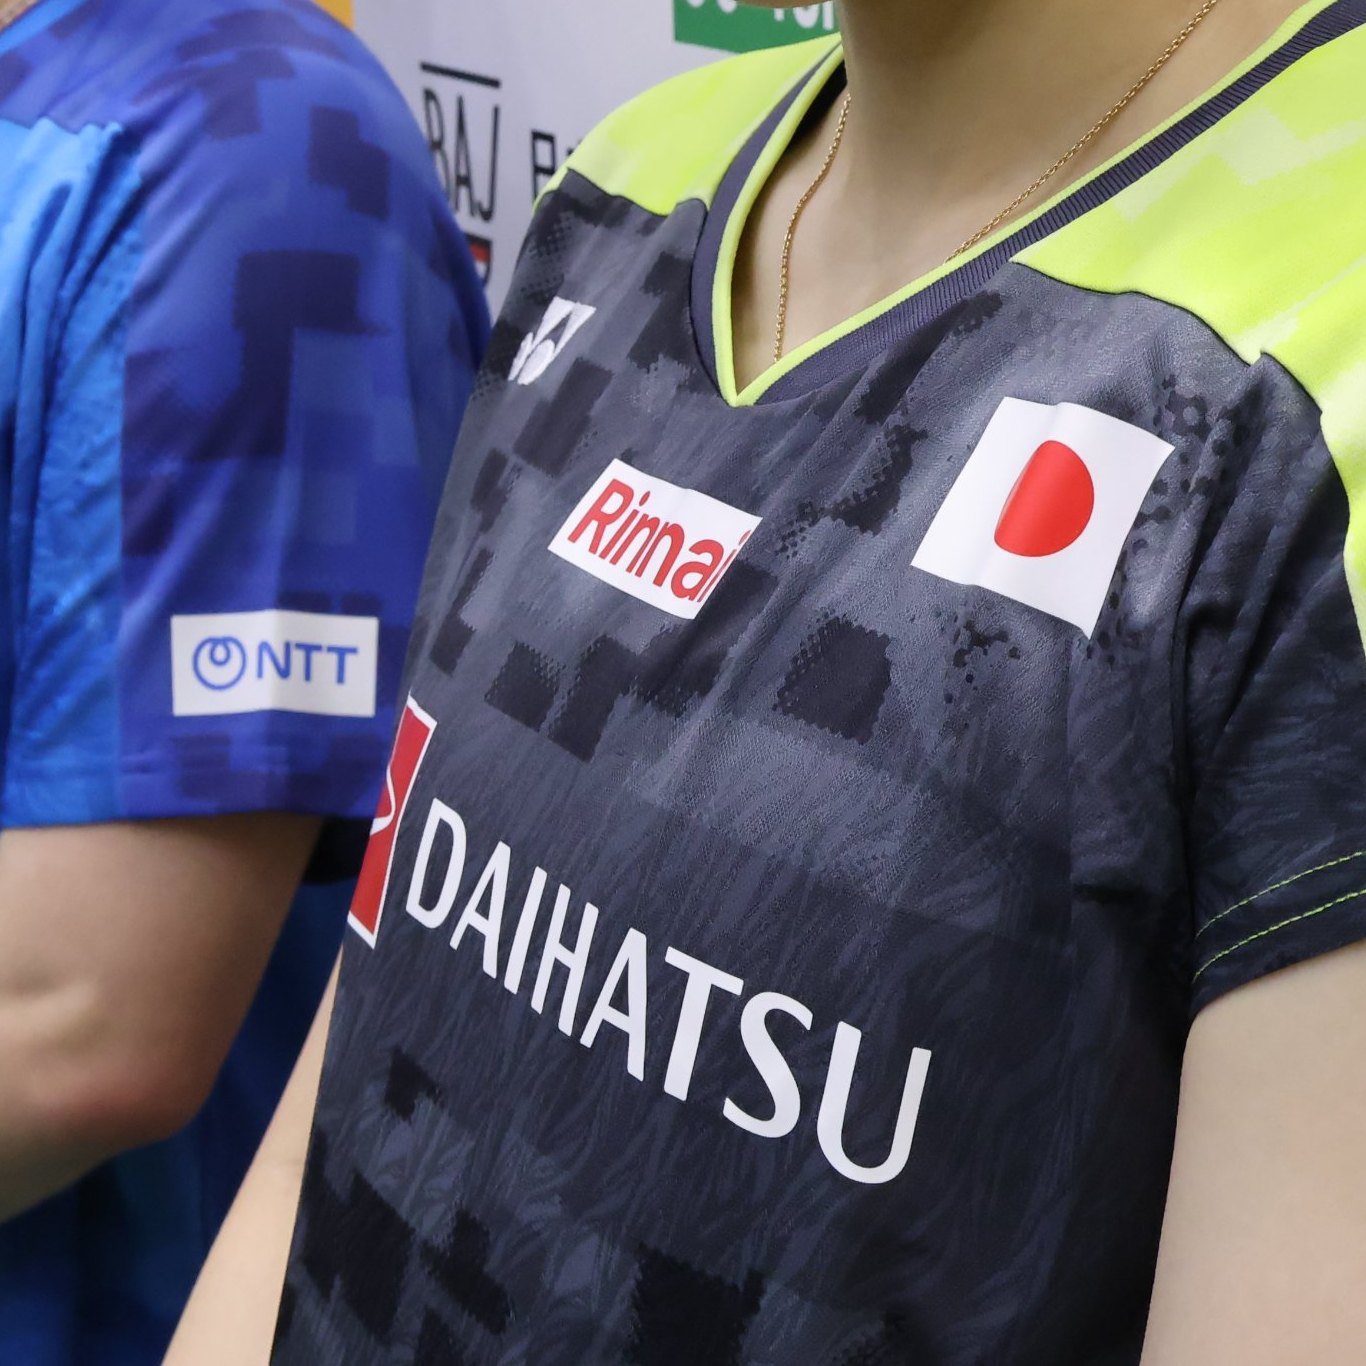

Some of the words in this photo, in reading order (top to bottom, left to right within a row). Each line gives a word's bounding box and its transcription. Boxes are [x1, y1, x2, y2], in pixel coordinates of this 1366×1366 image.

[567, 478, 752, 603] Rinnai
[255, 639, 358, 686] NTT
[405, 797, 933, 1185] DAIHATSU
